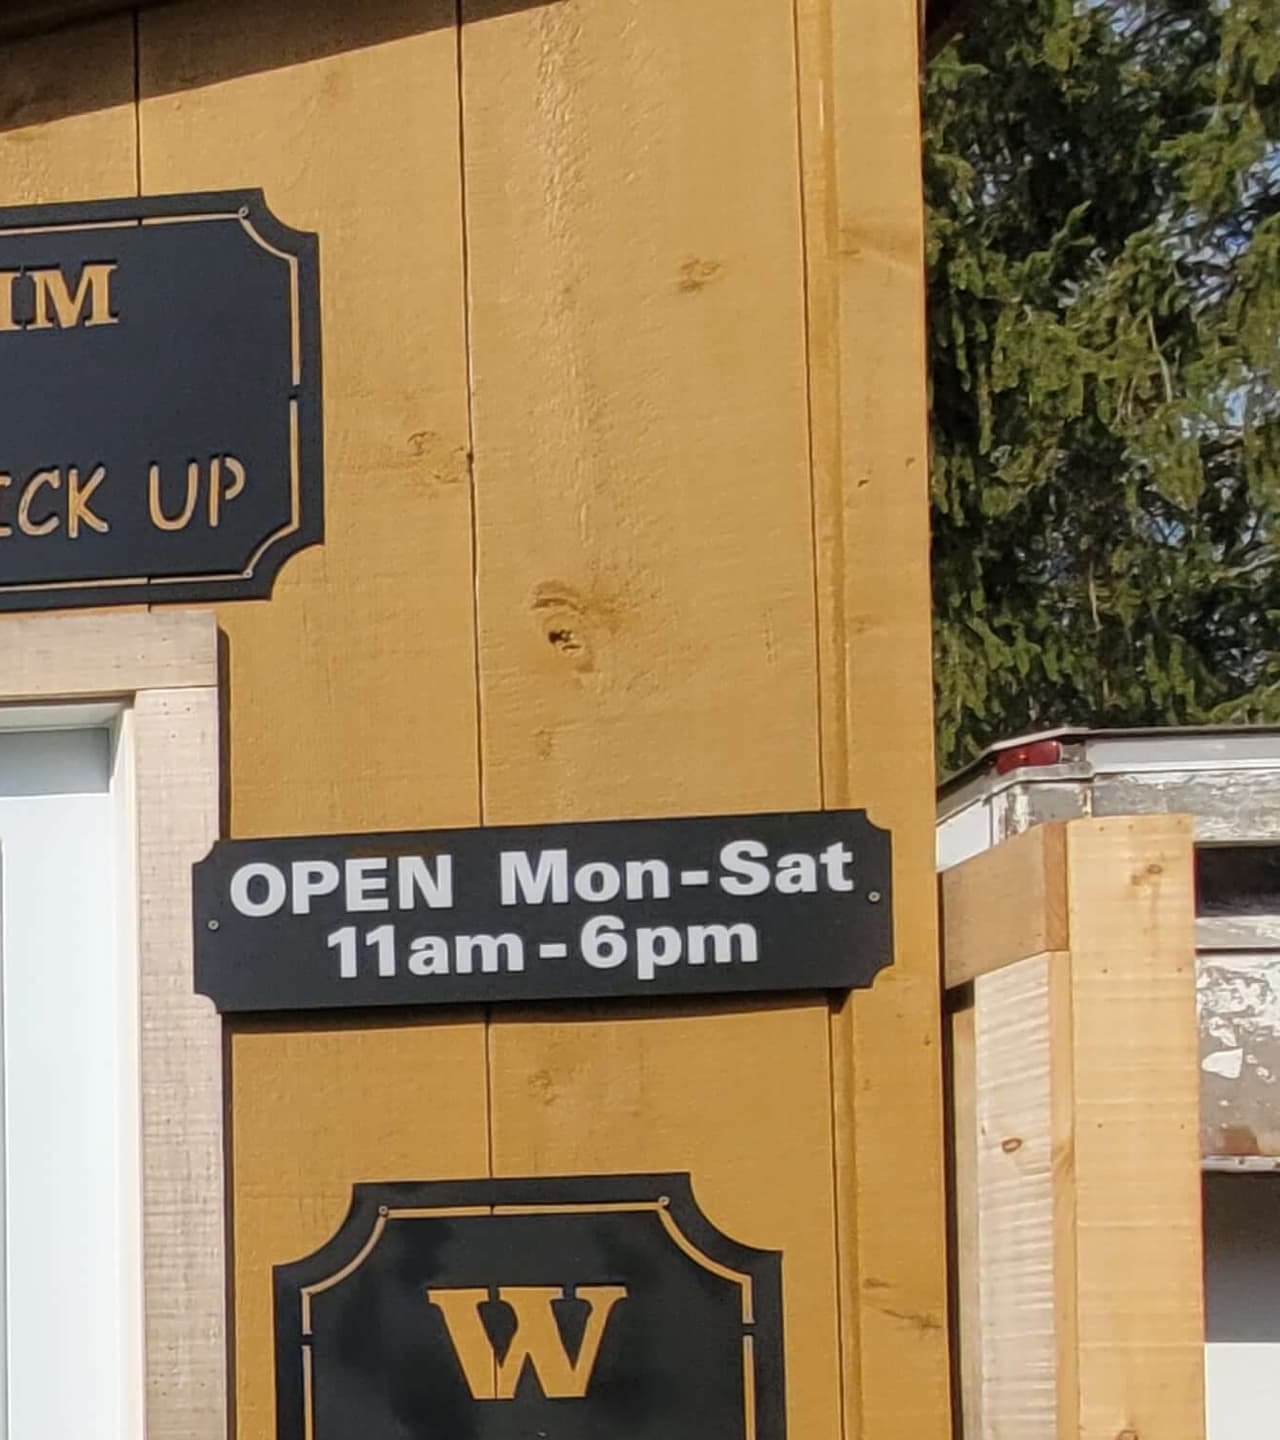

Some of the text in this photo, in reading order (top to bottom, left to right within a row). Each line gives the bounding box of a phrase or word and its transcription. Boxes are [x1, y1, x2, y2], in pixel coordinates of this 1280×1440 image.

[147, 454, 247, 532] UP
[230, 840, 855, 917] OPEN Mon-Sat
[326, 914, 760, 980] 11am-6pm
